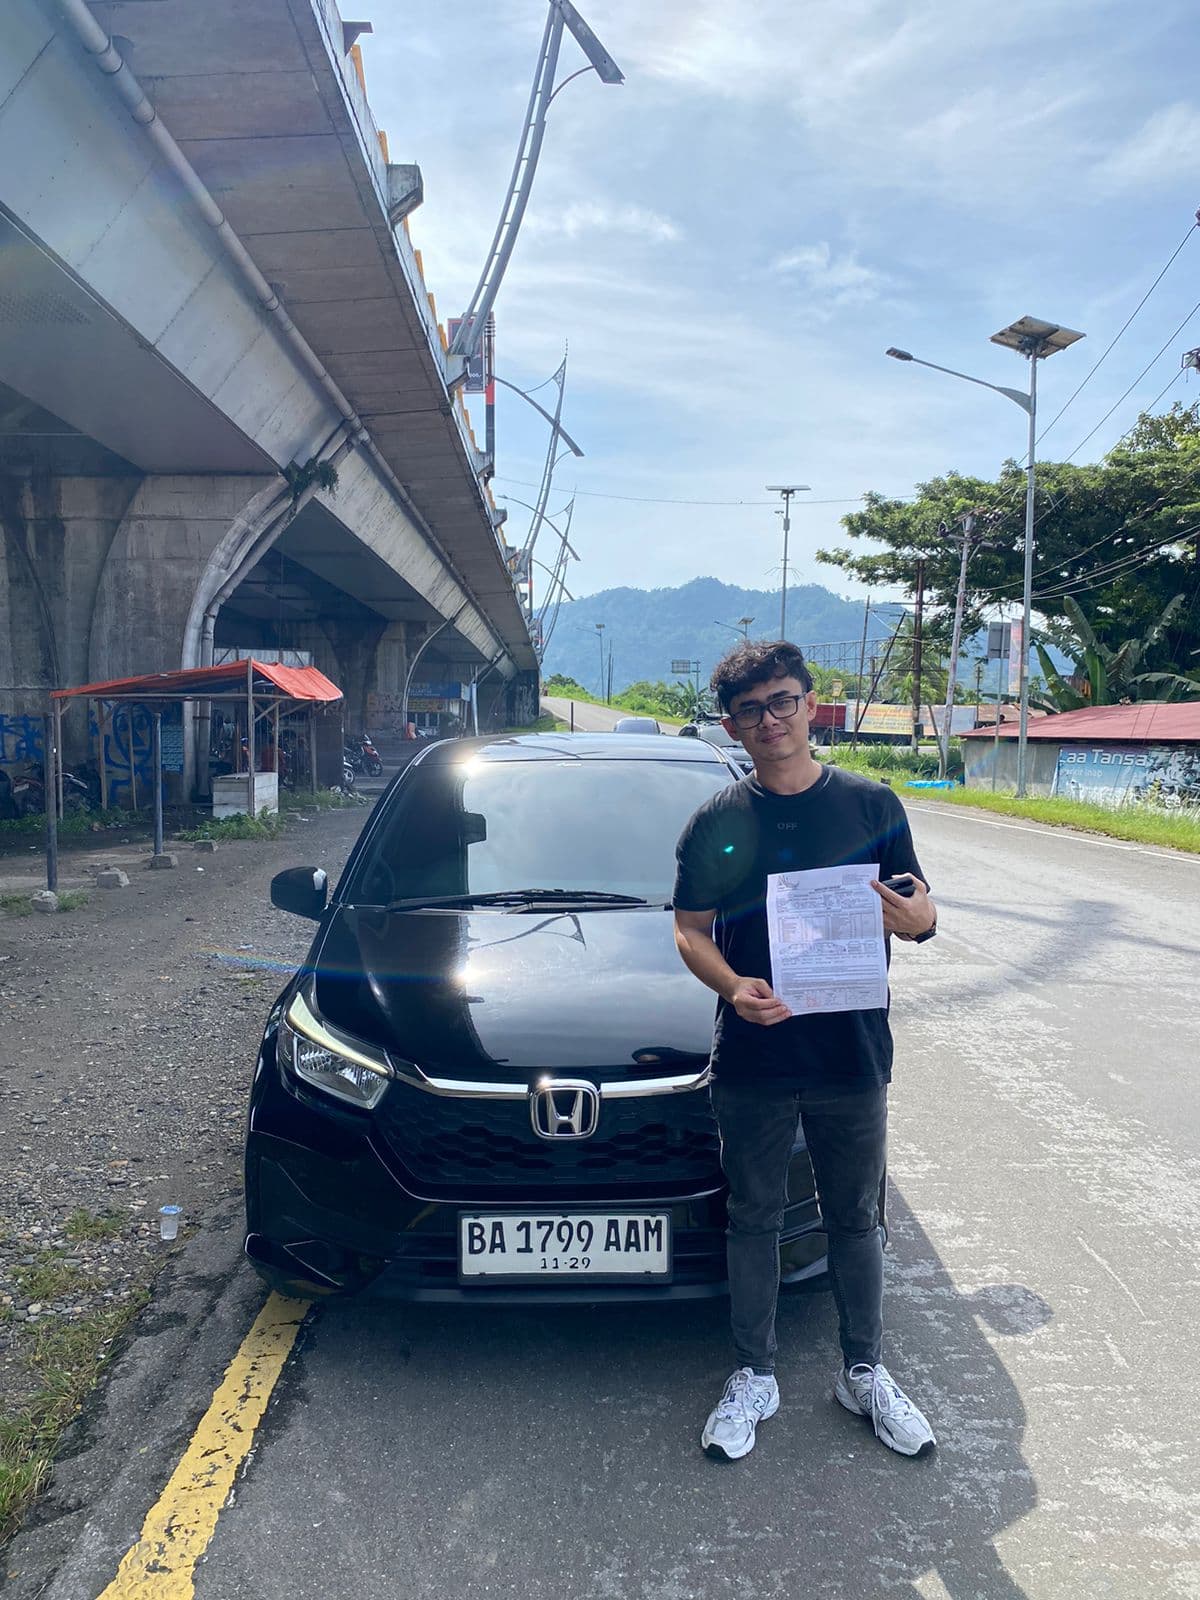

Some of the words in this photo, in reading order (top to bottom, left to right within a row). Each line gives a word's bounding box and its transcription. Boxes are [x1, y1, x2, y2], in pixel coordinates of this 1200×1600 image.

[1092, 749, 1148, 766] Tansa
[468, 1221, 506, 1255] BA
[516, 1220, 594, 1254] 1799
[604, 1219, 663, 1253] AAM
